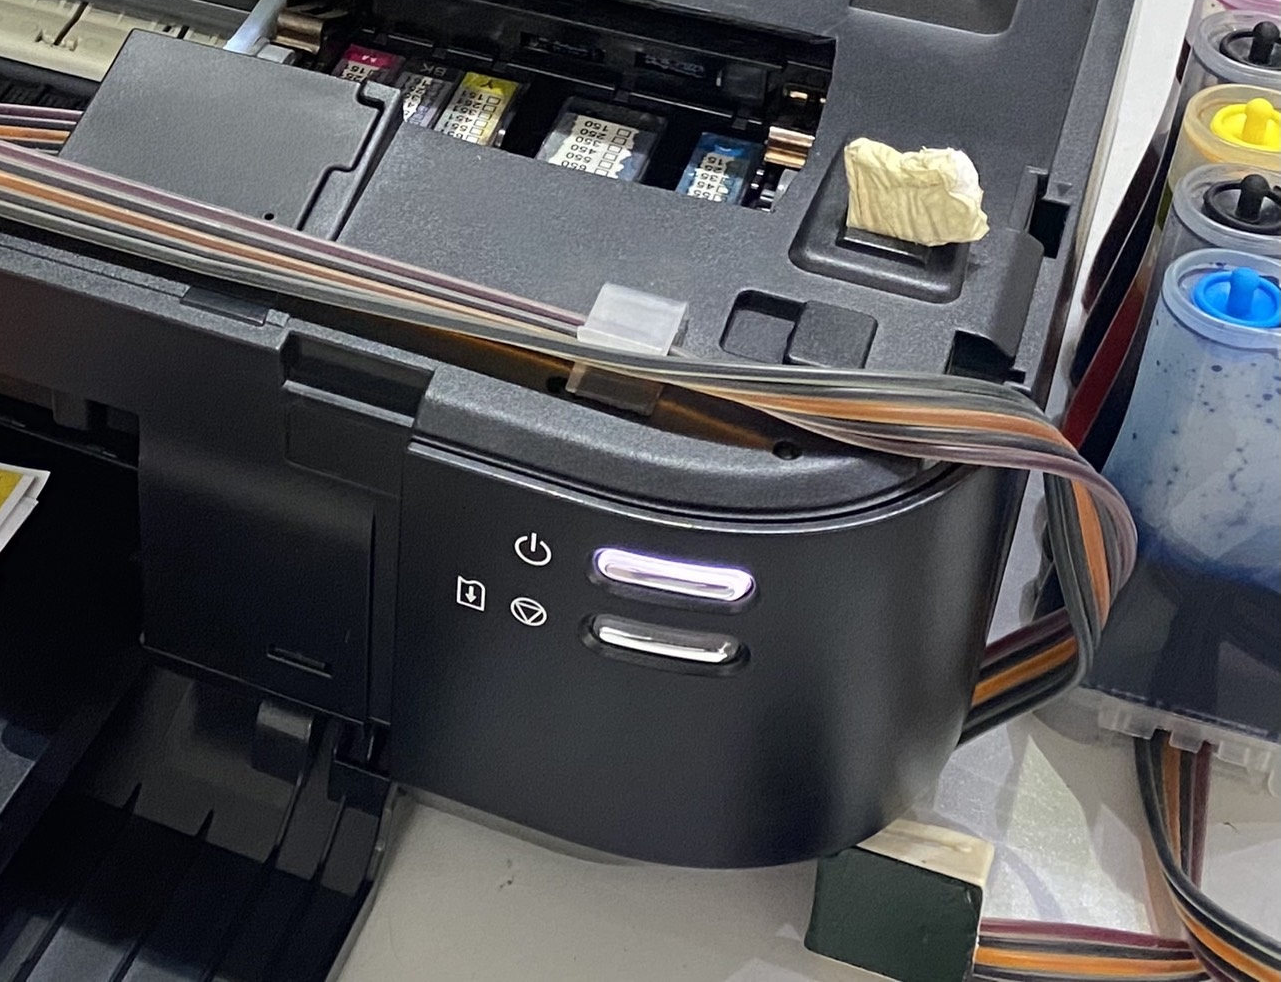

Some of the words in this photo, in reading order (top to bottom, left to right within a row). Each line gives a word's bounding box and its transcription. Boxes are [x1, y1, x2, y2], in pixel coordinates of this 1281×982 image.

[419, 62, 447, 76] BK
[480, 79, 494, 89] Y
[584, 120, 609, 132] 150
[580, 128, 606, 140] 250
[575, 136, 602, 148] 350
[571, 144, 597, 155] 450
[566, 152, 592, 164] 550
[561, 160, 587, 171] 650
